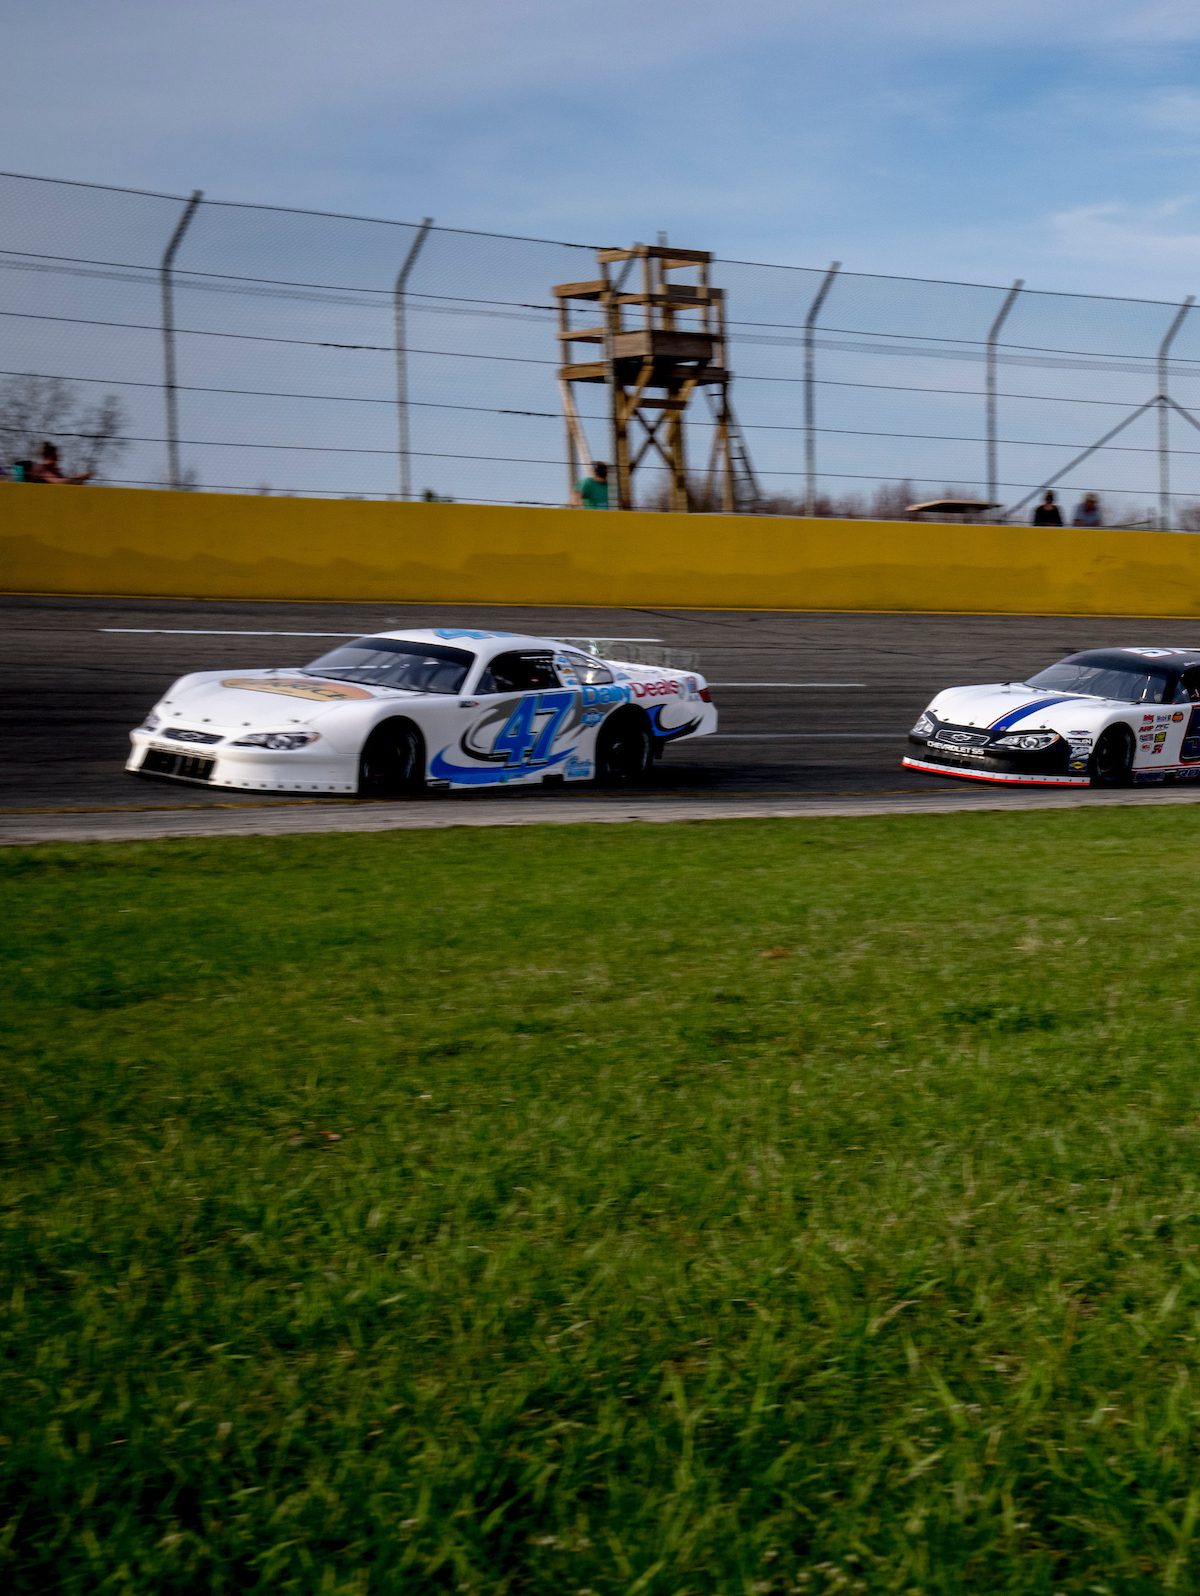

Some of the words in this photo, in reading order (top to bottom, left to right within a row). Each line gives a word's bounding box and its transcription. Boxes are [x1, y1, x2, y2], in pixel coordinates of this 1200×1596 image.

[631, 679, 679, 697] Deals
[491, 690, 578, 768] 47
[927, 740, 971, 753] CHEVROLET
[971, 747, 985, 756] SS
